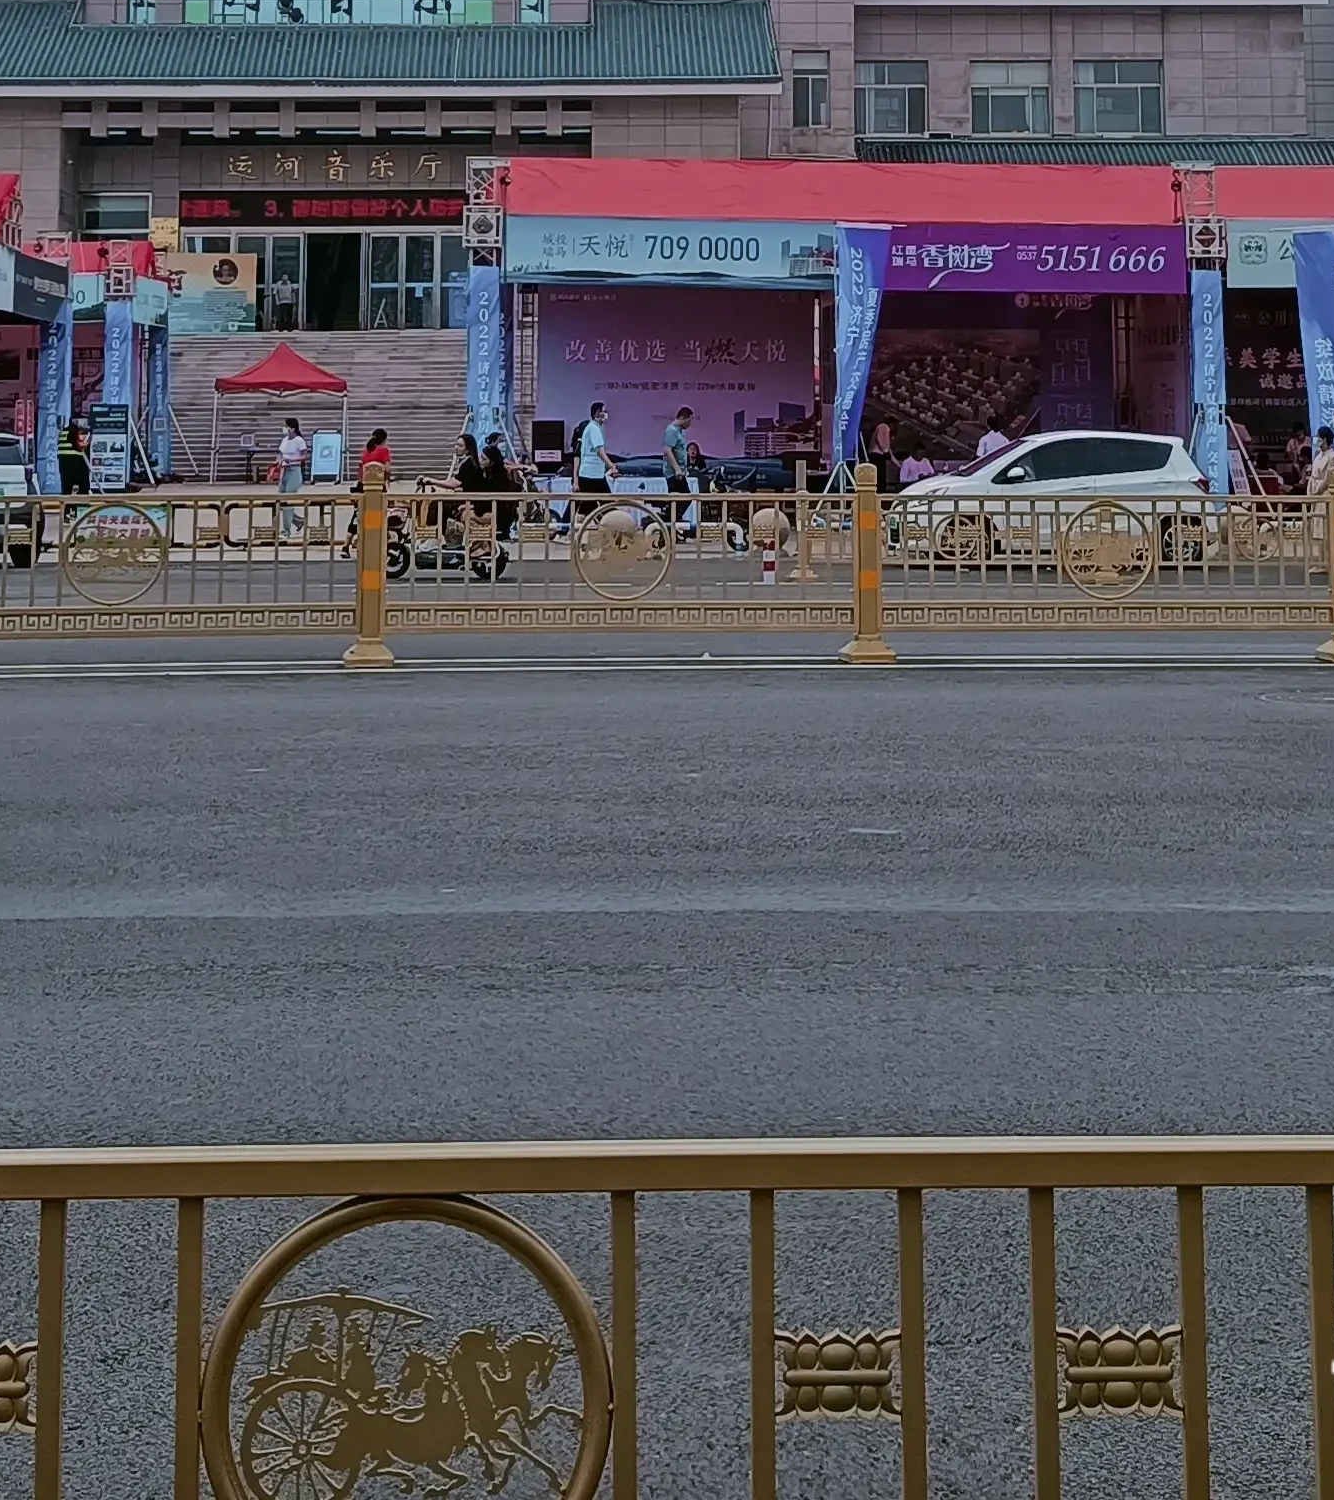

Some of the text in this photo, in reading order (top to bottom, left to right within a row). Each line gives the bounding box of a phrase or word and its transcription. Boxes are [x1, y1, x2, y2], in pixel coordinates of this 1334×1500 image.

[228, 151, 442, 182] 运河音乐厅
[578, 234, 760, 261] 天悦 709 0000
[1036, 245, 1099, 272] 5151
[1108, 245, 1166, 273] 666
[565, 339, 666, 363] 改善优选
